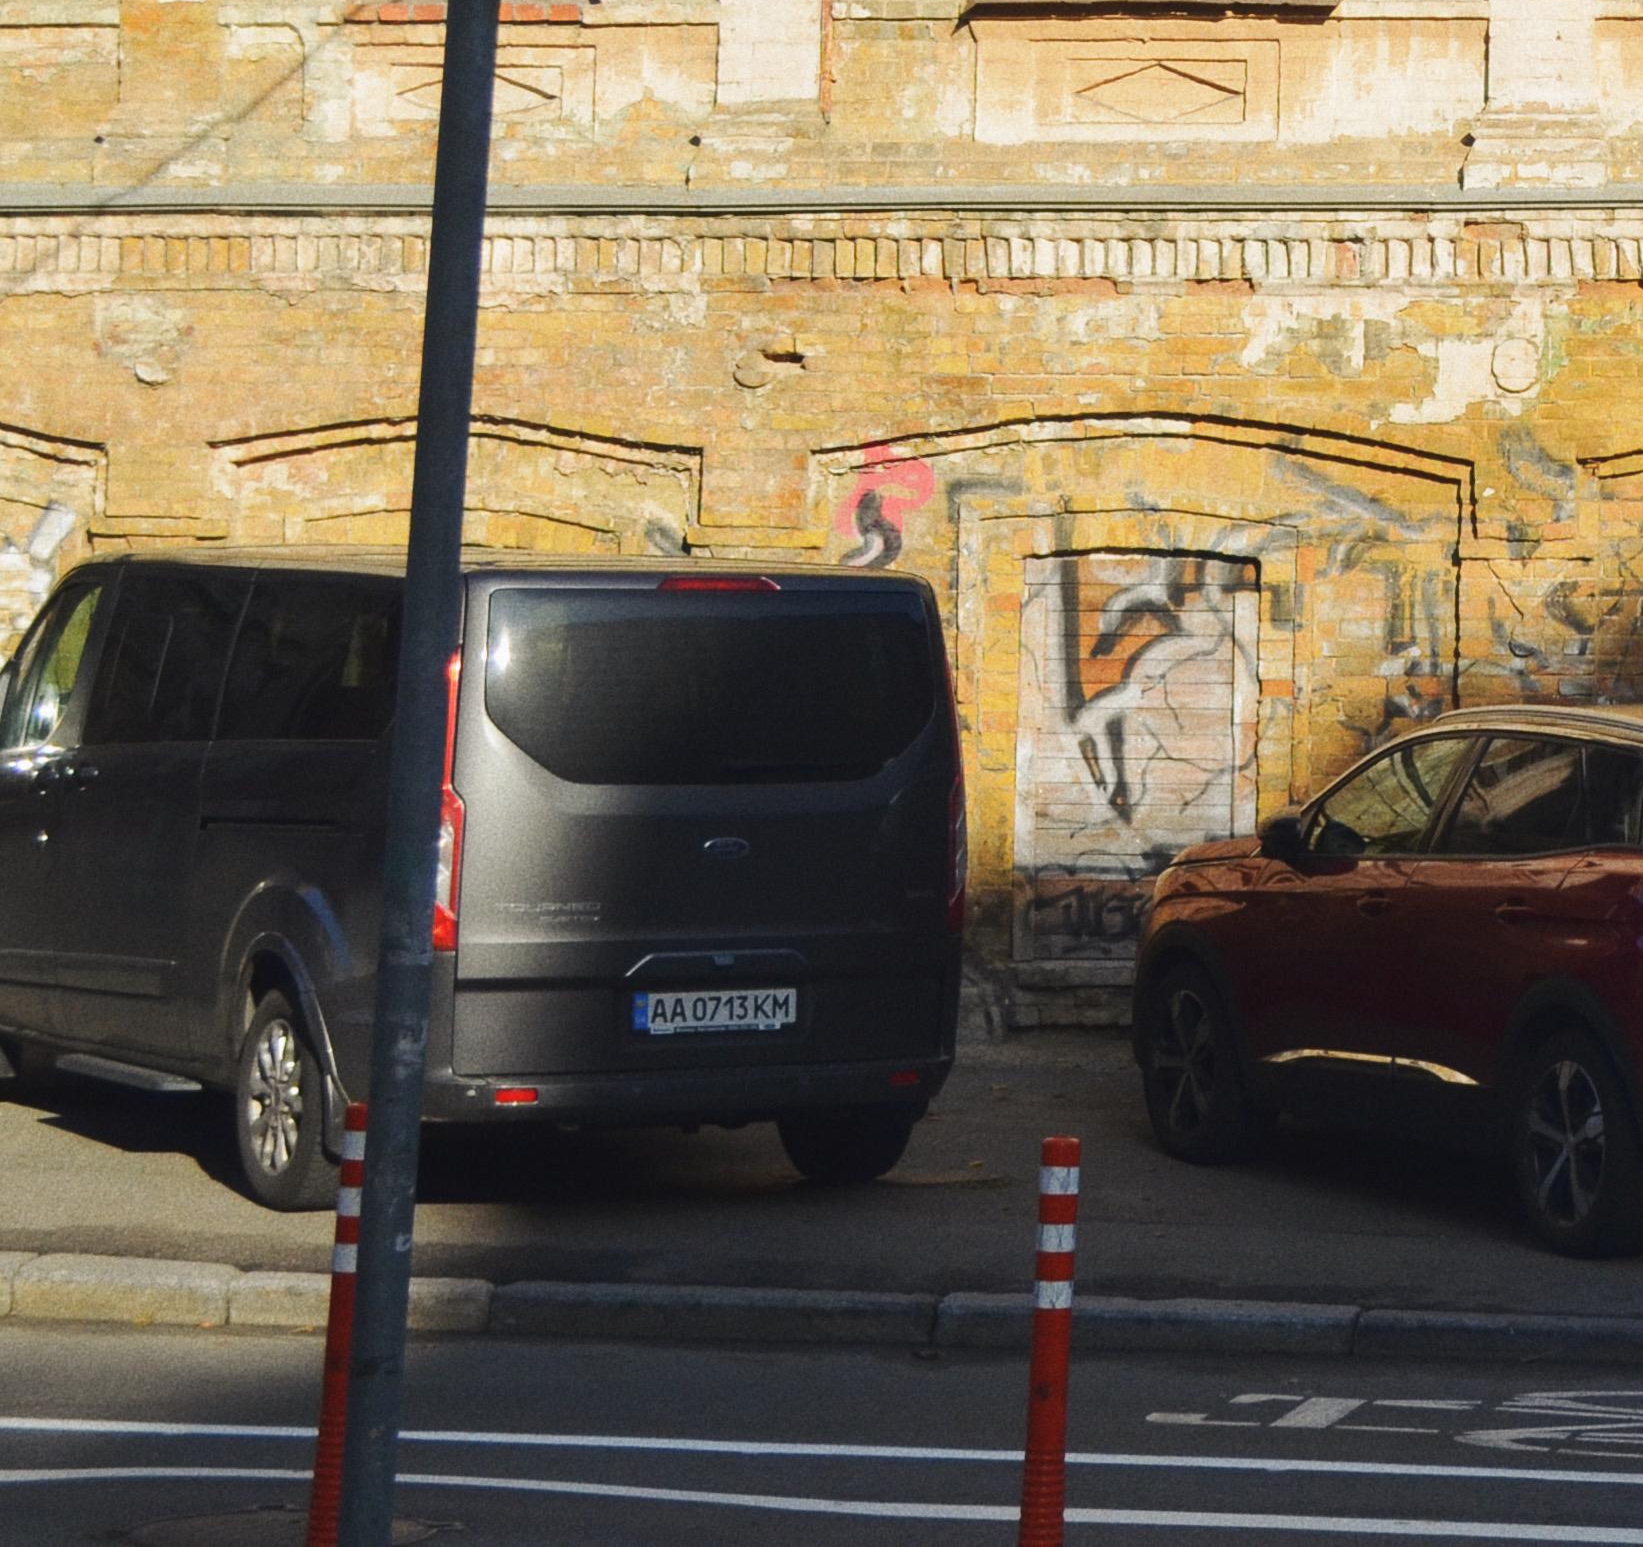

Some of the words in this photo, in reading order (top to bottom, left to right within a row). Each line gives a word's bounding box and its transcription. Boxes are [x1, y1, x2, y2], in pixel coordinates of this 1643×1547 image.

[651, 997, 688, 1024] AA
[692, 995, 749, 1022] 0713
[754, 994, 791, 1020] KM
